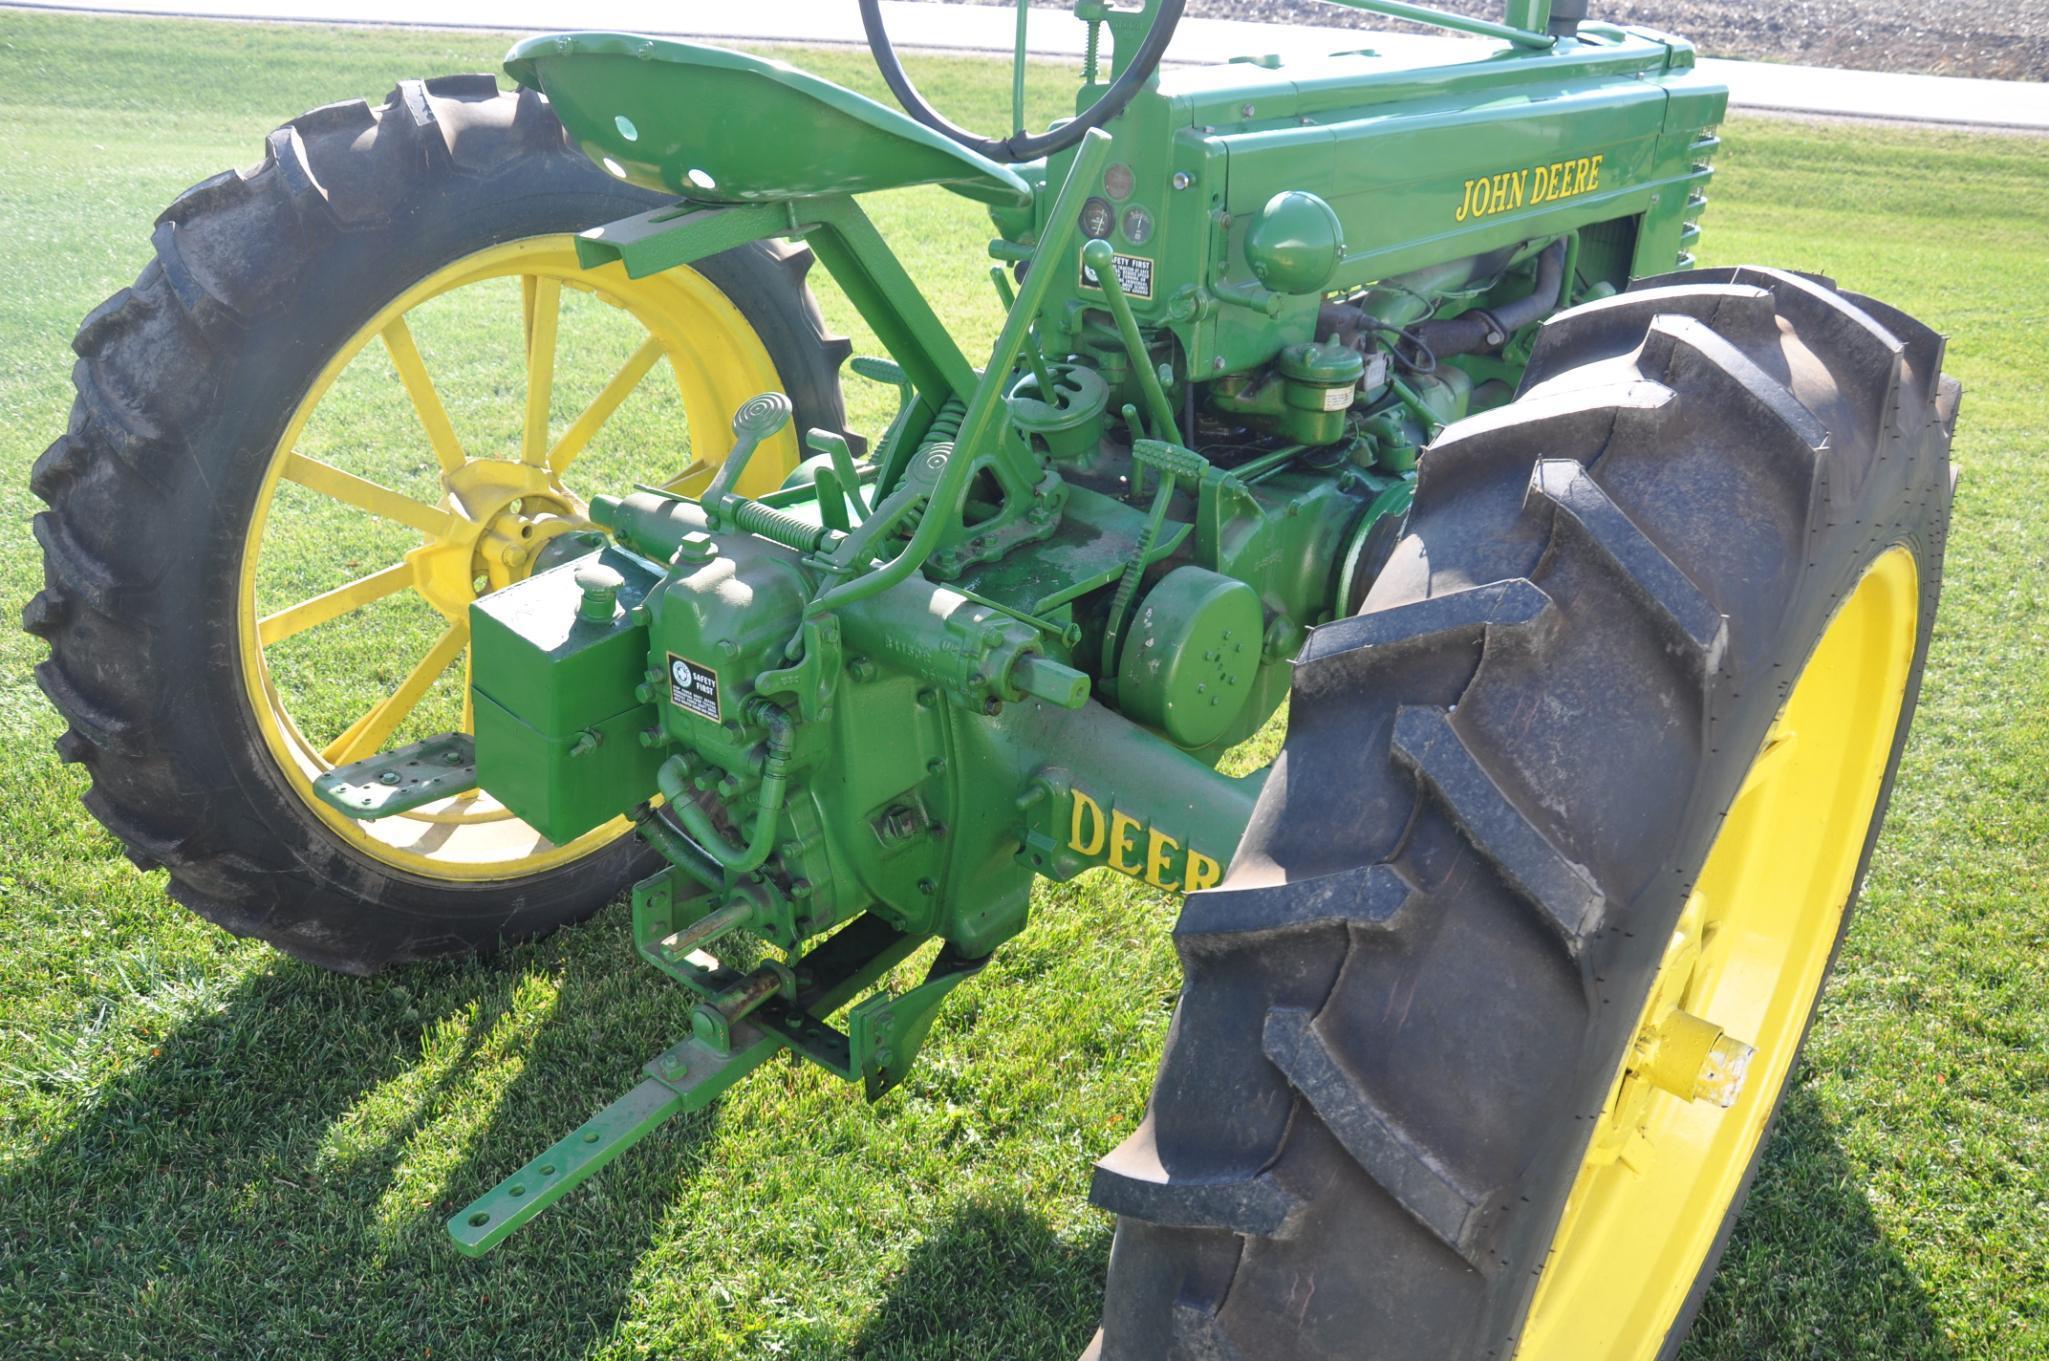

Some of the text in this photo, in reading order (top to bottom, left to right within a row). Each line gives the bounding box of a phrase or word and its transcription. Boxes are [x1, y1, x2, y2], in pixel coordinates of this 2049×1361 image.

[1455, 155, 1603, 222] JOHN DEERE
[1112, 256, 1150, 269] FETY FIRST
[692, 672, 716, 688] SAFETY
[696, 682, 713, 695] FIRST
[1067, 787, 1221, 893] DEER
